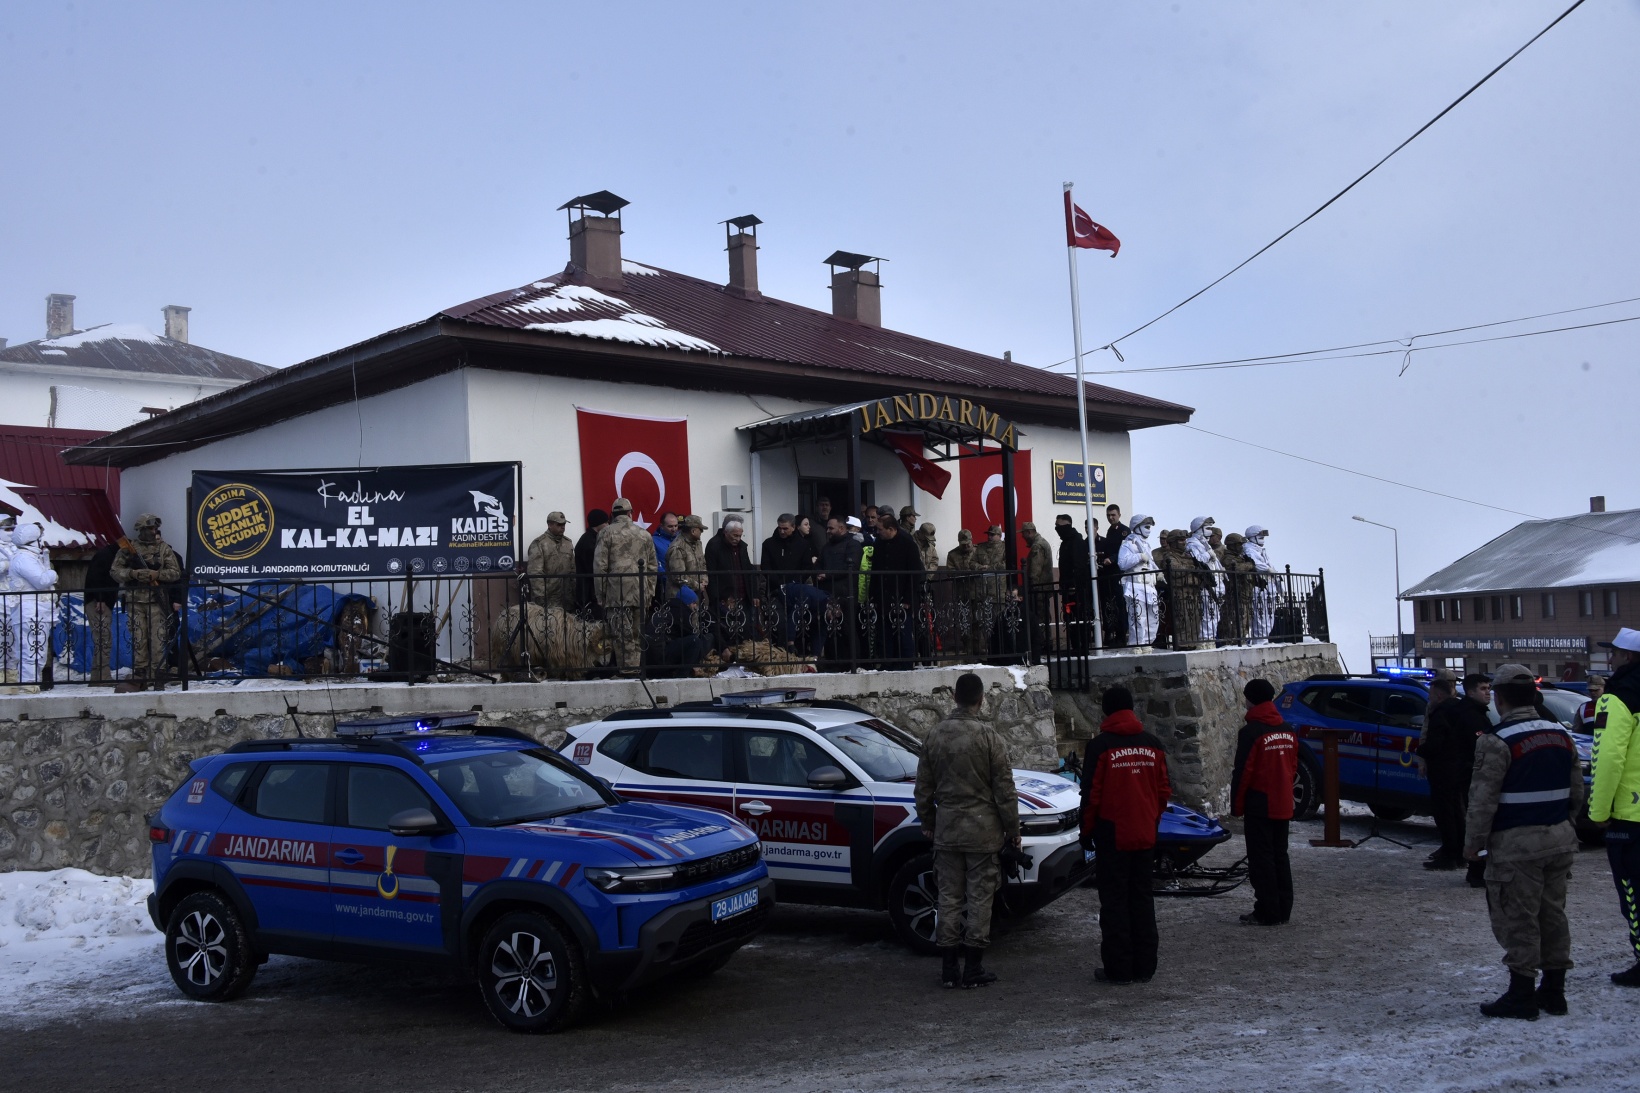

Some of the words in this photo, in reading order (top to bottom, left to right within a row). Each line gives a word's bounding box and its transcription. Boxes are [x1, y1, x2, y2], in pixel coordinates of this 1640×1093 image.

[859, 393, 1015, 449] JANDARMA
[207, 489, 246, 510] KADINA
[207, 500, 260, 530] ŞİDDET
[348, 506, 374, 525] EL
[452, 516, 509, 533] KADES
[212, 512, 265, 540] İNSANLIK
[215, 523, 267, 549] SUÇUDUR
[281, 527, 438, 549] KAL-KA-MAZ!
[478, 533, 508, 541] DESTEK
[194, 565, 249, 575] GÜMÜŞHANE
[251, 564, 259, 574] İL
[261, 564, 308, 573] JANDARMA
[310, 562, 370, 573] KOMUTANLIĞI
[1528, 637, 1549, 647] HÜSEYİN
[1550, 637, 1570, 647] ZİGANA
[1572, 637, 1586, 647] DAĞI
[1263, 733, 1294, 744] JANDARMA
[1519, 733, 1567, 754] JANDARMA
[577, 746, 590, 756] 112
[1110, 747, 1156, 761] JANDARMA
[191, 782, 205, 793] 112
[224, 835, 316, 864] JANDARMA
[716, 901, 727, 918] 29
[728, 895, 743, 913] JAA
[744, 889, 757, 907] 045
[335, 904, 434, 923] www.jandarma.gov.tr
